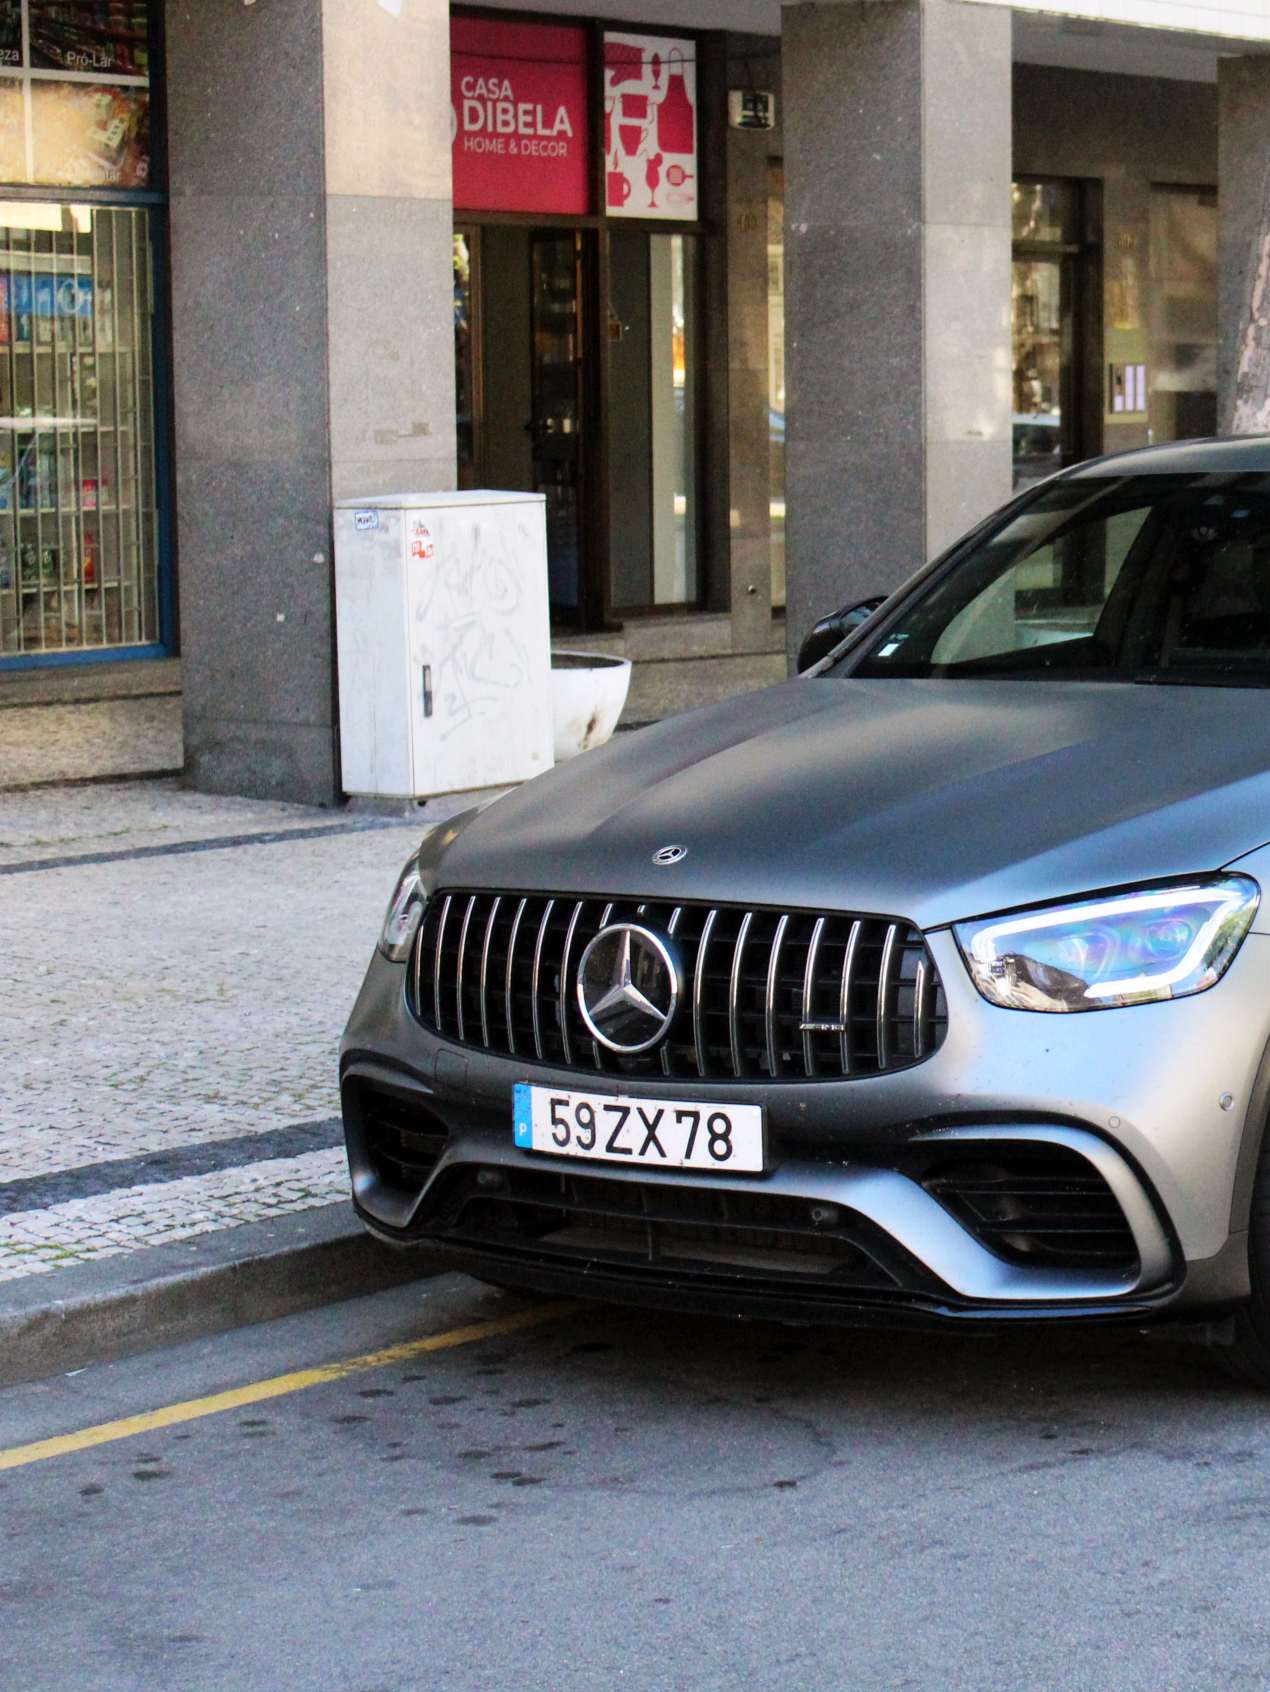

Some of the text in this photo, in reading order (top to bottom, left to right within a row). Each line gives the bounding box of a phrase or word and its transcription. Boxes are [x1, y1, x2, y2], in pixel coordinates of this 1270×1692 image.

[66, 51, 112, 68] Pró-Lar
[461, 76, 514, 100] CASA
[463, 100, 573, 137] DIBELA
[464, 137, 567, 156] HOME & DECOR
[519, 1123, 528, 1137] P
[550, 1097, 733, 1162] 59ZX78
